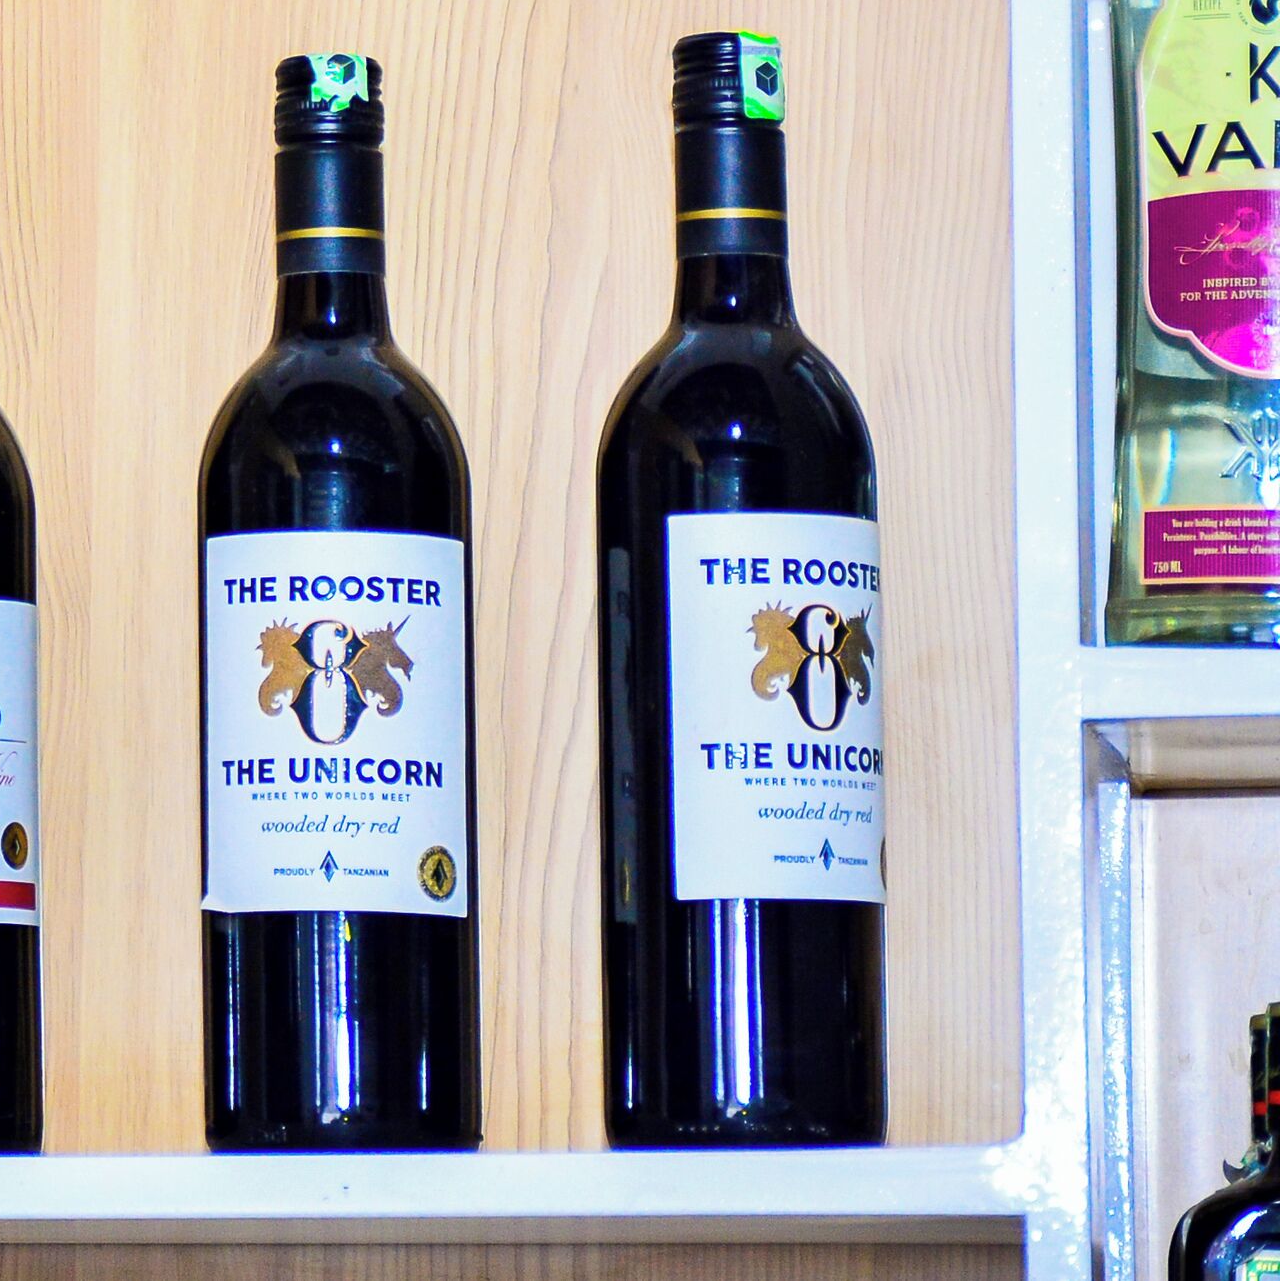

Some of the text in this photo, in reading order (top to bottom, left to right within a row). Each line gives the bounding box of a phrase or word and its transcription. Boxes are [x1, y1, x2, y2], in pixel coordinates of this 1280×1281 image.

[1202, 277, 1257, 288] INSPIRED
[1180, 292, 1201, 302] FOR
[1204, 290, 1228, 300] THE
[700, 558, 770, 585] THE
[1153, 561, 1169, 573] 750
[224, 575, 442, 607] THE ROOSTER
[700, 743, 883, 777] THE UNICOR
[222, 757, 443, 788] THE UNICORN
[744, 778, 786, 786] WHERE
[793, 778, 817, 787] TWO
[251, 791, 411, 802] WHERE TWO WORLDS MEET
[758, 801, 873, 826] wooded dry red
[261, 814, 401, 838] wooded dry red
[773, 855, 815, 864] PROUDLY
[273, 867, 390, 878] PROUDLY TANZANIAN
